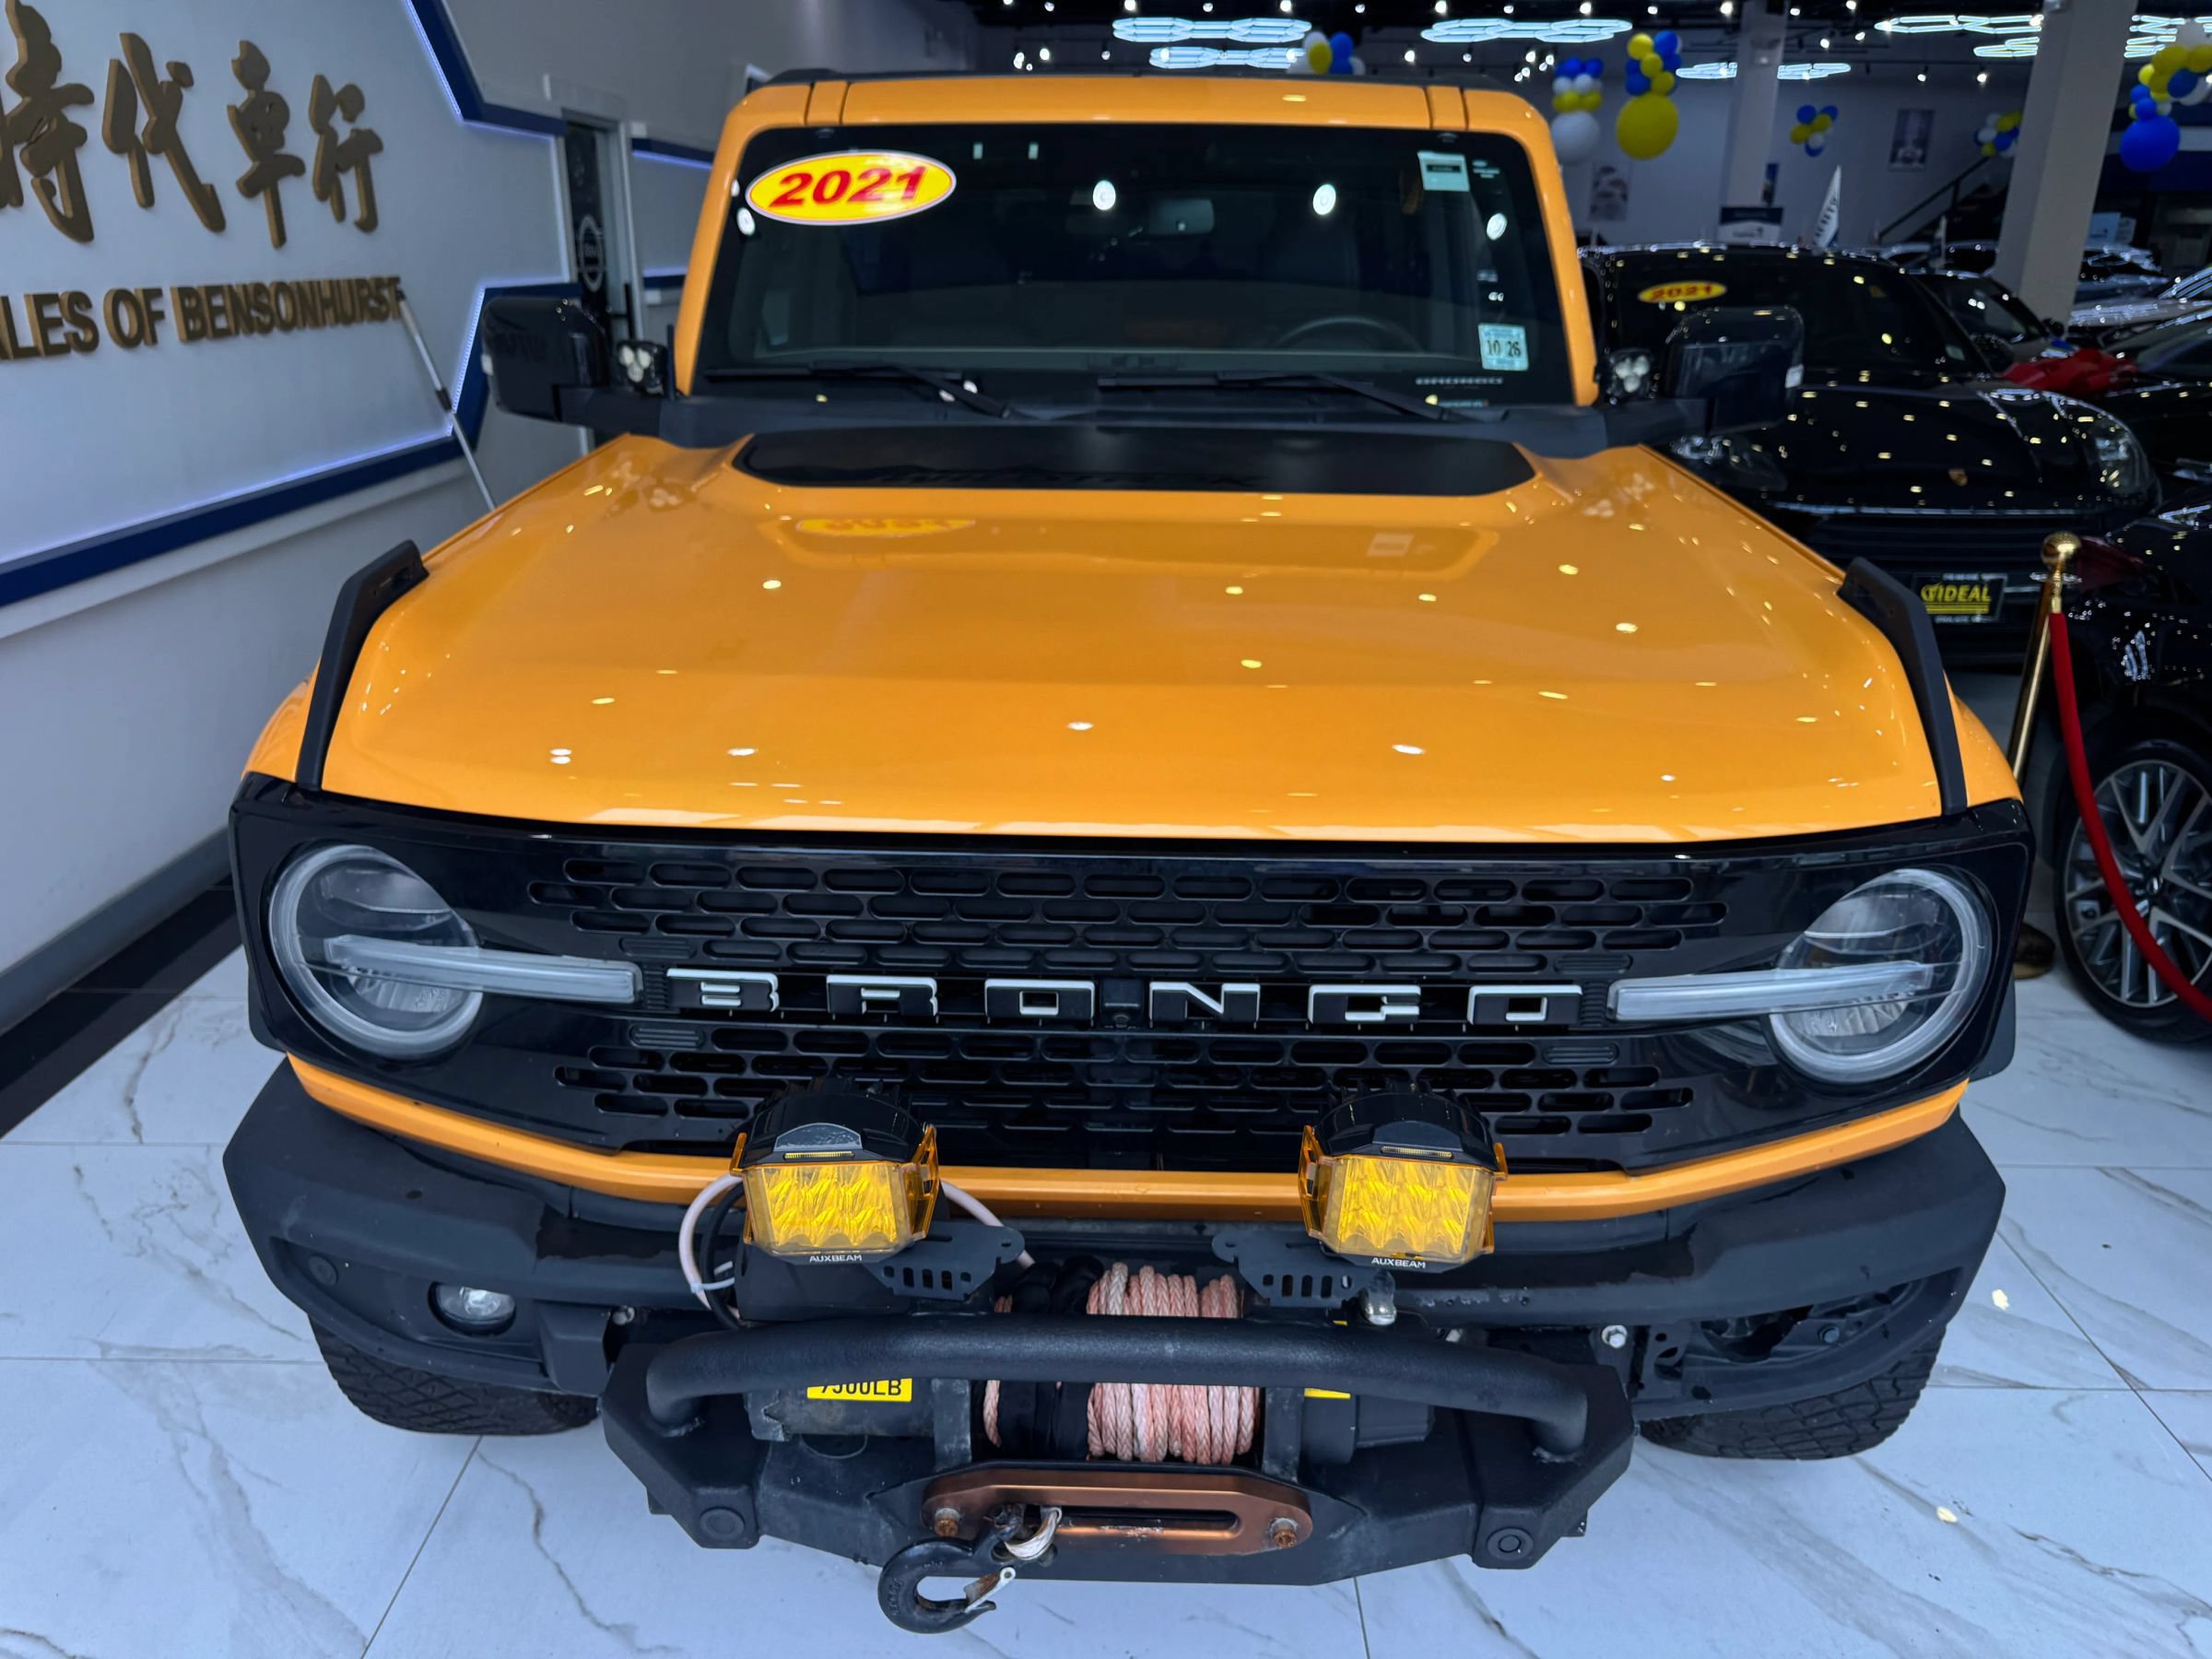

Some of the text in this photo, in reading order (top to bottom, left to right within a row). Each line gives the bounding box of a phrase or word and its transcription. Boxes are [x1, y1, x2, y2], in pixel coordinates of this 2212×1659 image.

[768, 166, 927, 207] 2021
[1651, 283, 1712, 300] 2021
[0, 276, 400, 359] LES OF BENSONHURST
[1487, 339, 1501, 355] 10
[666, 968, 1583, 1026] BRONCO
[809, 1254, 863, 1263] AUXBEAM
[1370, 1257, 1426, 1268] AUXBEAM
